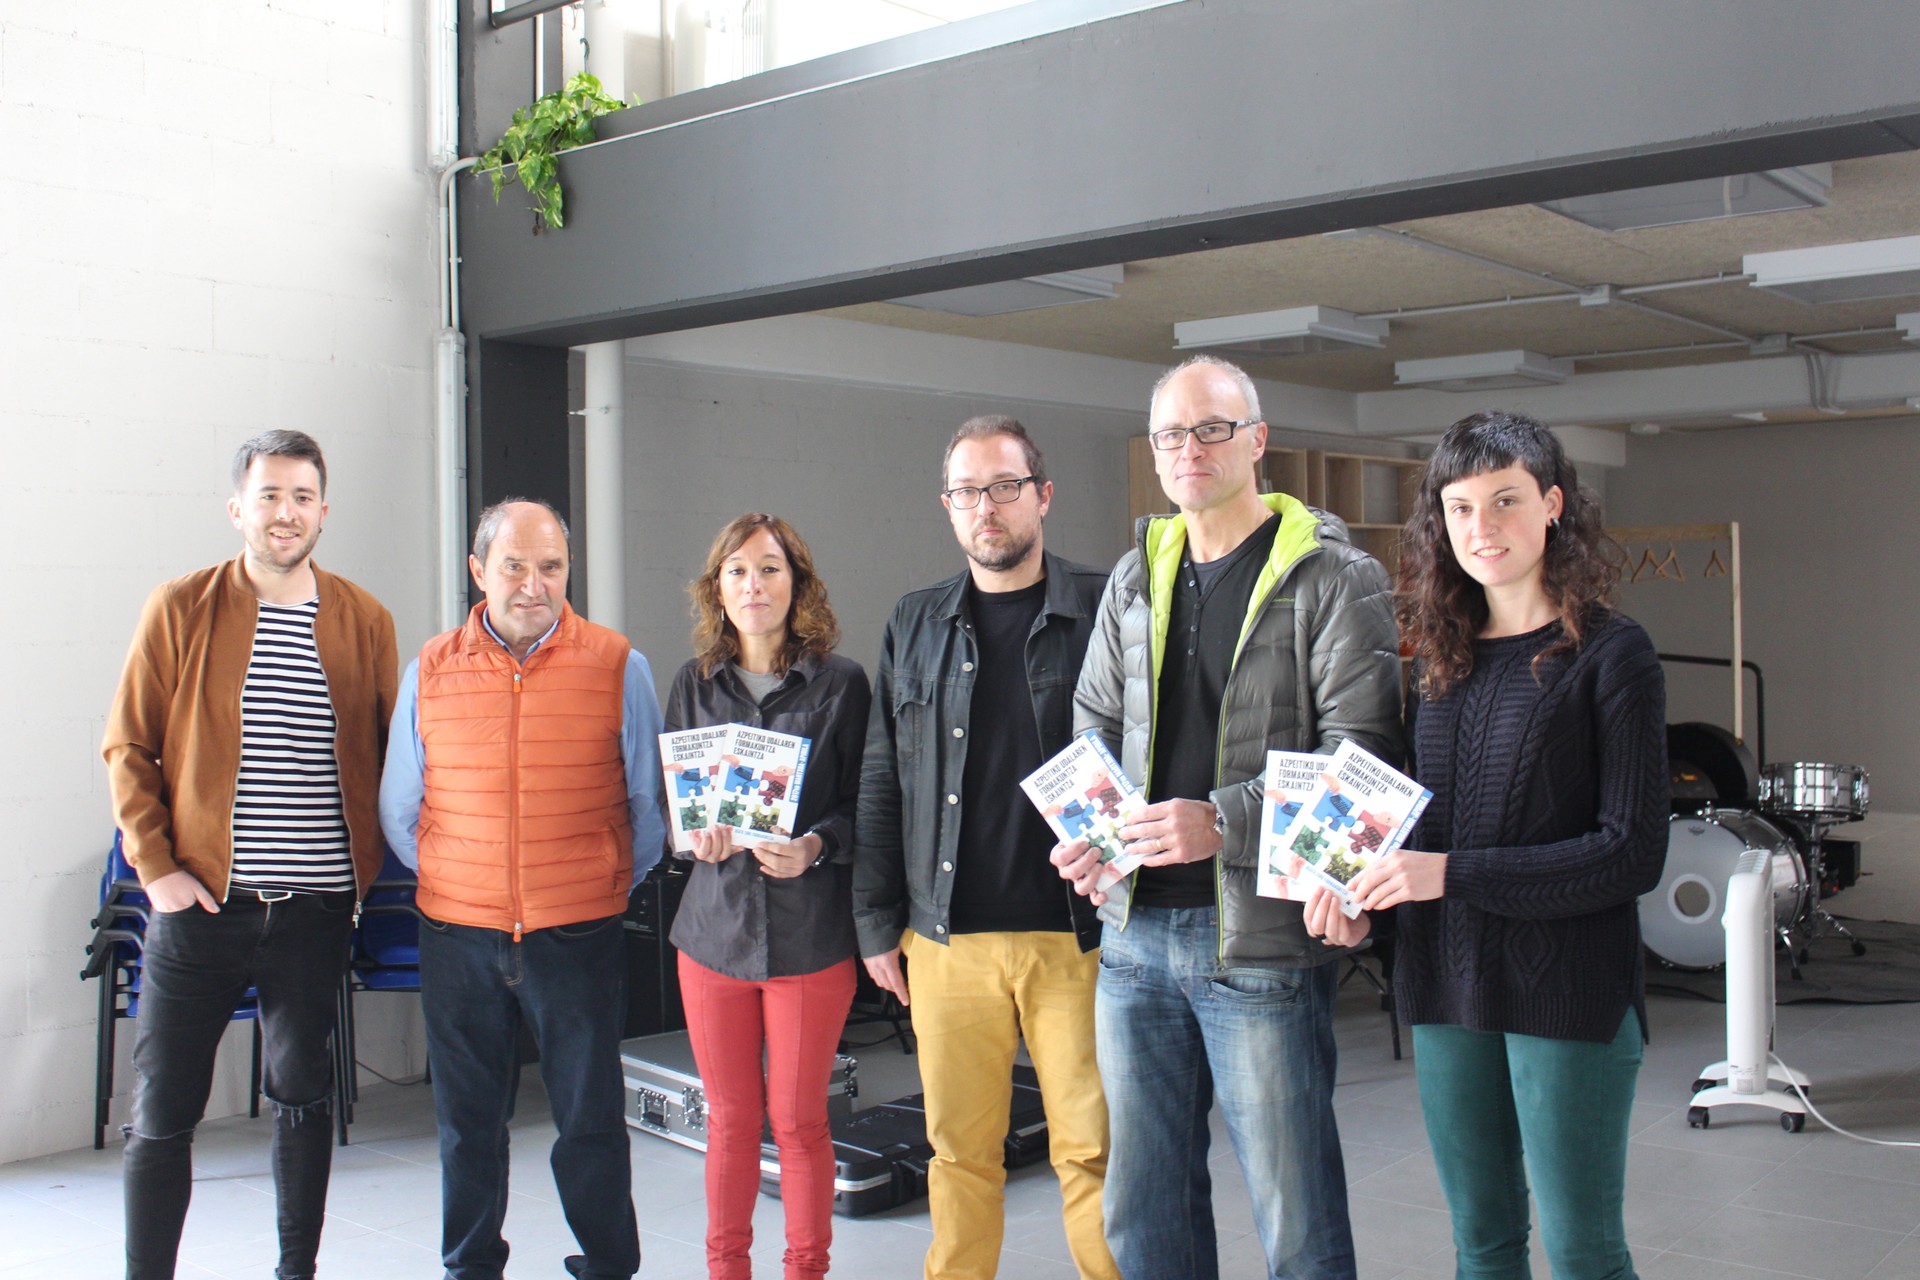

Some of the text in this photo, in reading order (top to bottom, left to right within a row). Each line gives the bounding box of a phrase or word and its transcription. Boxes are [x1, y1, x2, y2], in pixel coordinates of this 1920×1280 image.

[671, 734, 700, 744] AZPEITIKO
[671, 740, 713, 753] FORMAKUNTZA
[735, 738, 776, 753] FORMAKUNTZA
[737, 730, 796, 749] AZPEITIKO UDALAREN
[673, 750, 705, 761] ESKAINTZA
[733, 746, 765, 760] ESKAINTZA
[1033, 744, 1088, 788] AZPEITIKO UDALAREN
[1279, 758, 1315, 771] AZPEITIKO
[1038, 765, 1078, 796] FORMAKUNTZA
[1278, 769, 1322, 781] FORMAKUNT
[1337, 769, 1373, 797] ESKAINTZA
[1342, 760, 1389, 795] FORMAKUNTZA
[1347, 752, 1414, 798] AZPEITIKO UDALAREN
[1044, 779, 1075, 804] ESKAINTZA
